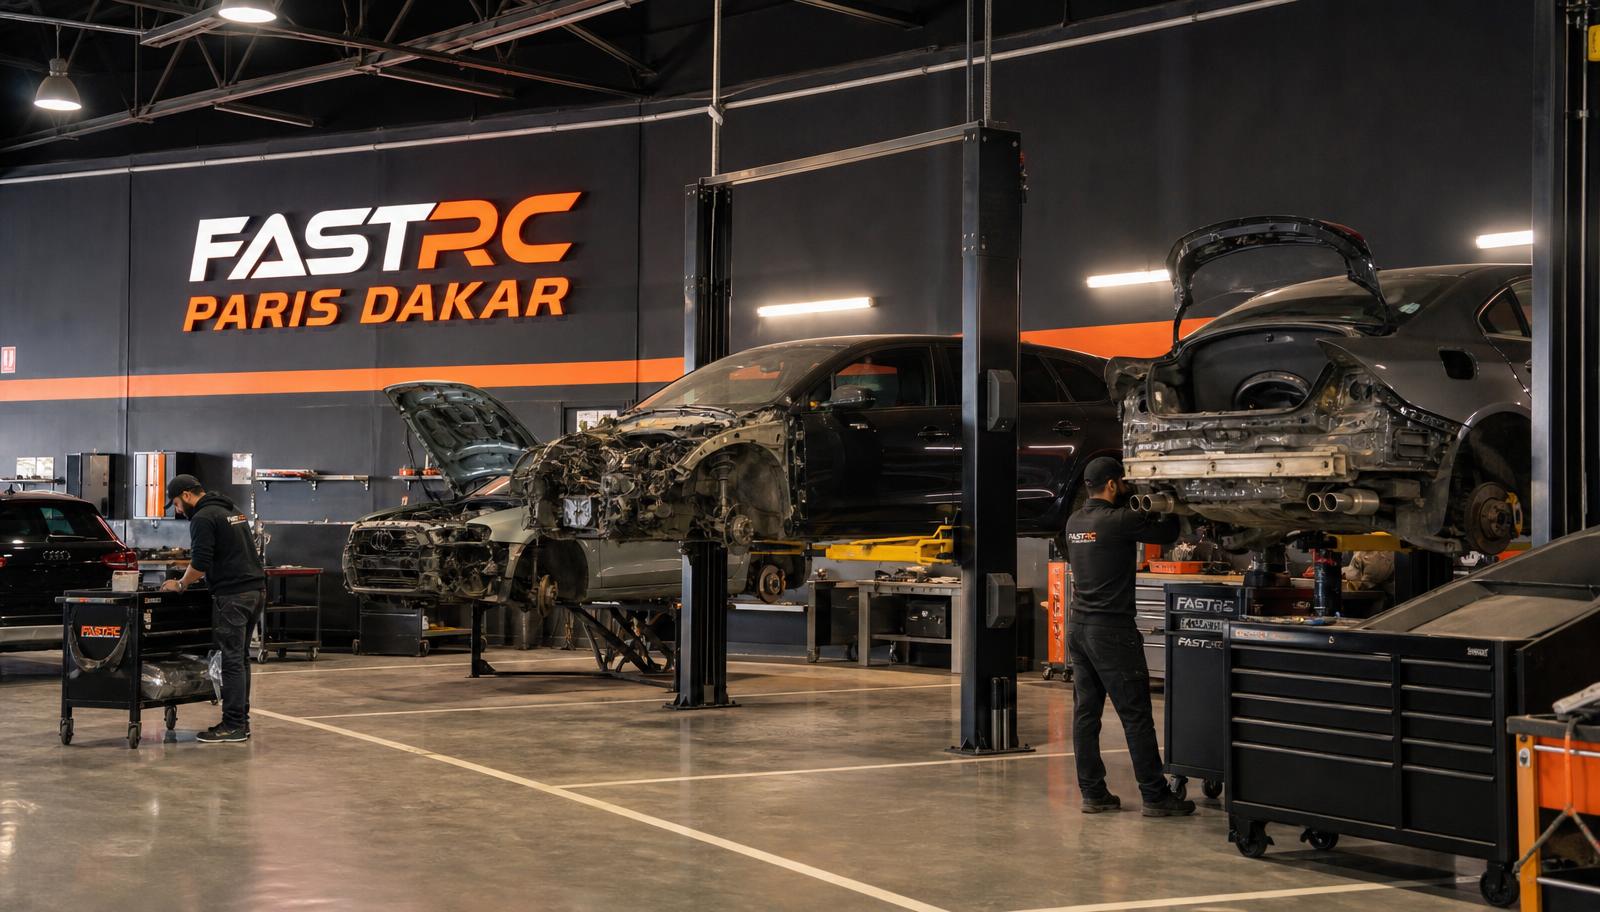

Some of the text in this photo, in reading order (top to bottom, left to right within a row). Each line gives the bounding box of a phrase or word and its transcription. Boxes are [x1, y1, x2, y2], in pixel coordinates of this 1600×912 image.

[189, 192, 582, 281] FASTRC
[183, 276, 571, 332] PARIS DAKAR
